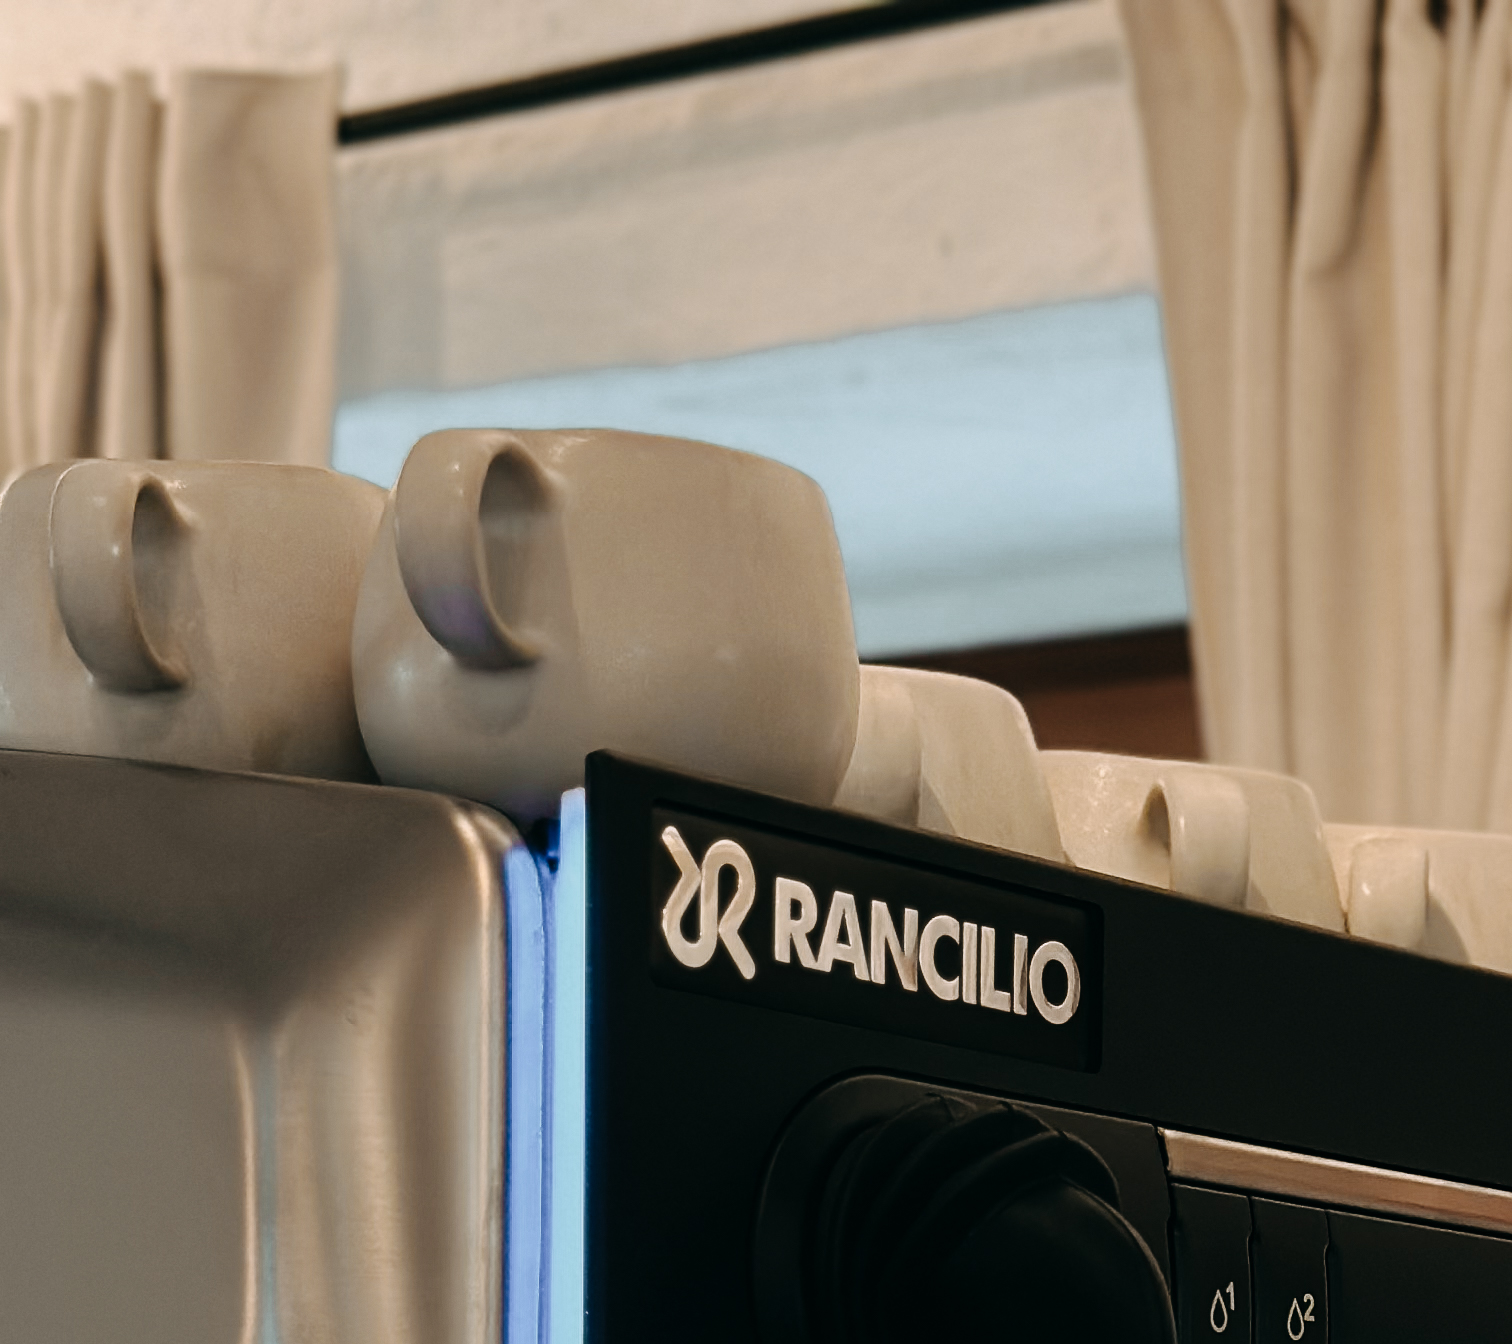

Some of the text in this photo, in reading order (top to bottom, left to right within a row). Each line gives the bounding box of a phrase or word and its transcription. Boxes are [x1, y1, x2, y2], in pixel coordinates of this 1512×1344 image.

[774, 876, 1081, 1025] RANCILIO
[1226, 1281, 1235, 1311] 1
[1303, 1293, 1315, 1322] 2
